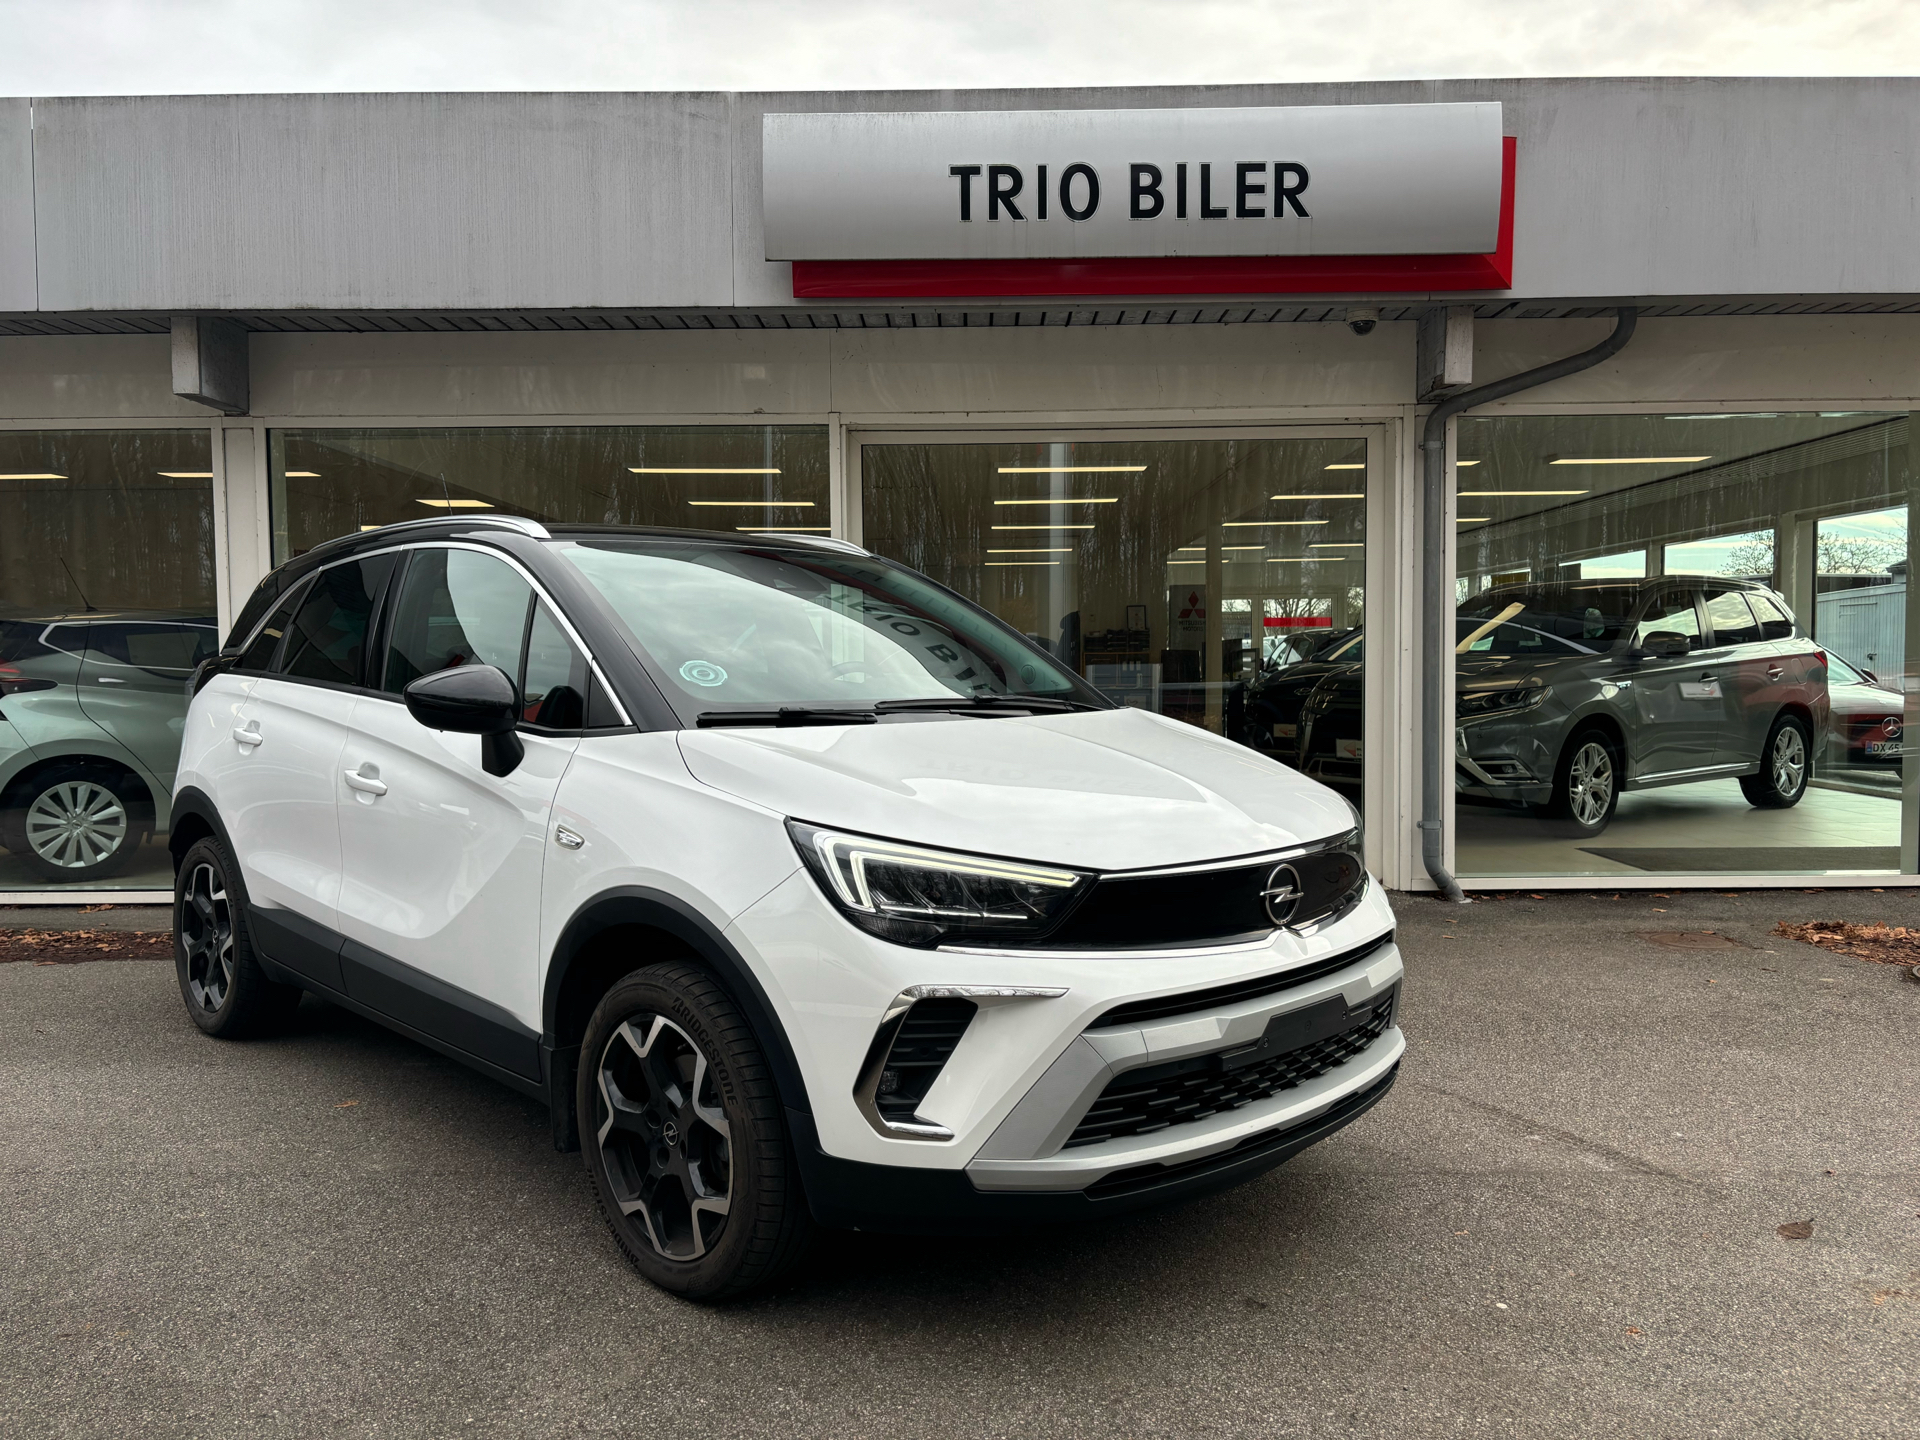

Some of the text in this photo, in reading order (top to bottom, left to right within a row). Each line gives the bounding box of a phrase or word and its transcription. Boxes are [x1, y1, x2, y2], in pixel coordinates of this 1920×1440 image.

[948, 161, 1312, 223] TRIO BILER
[1872, 743, 1887, 753] DX
[671, 996, 739, 1106] BRIDGESTONE
